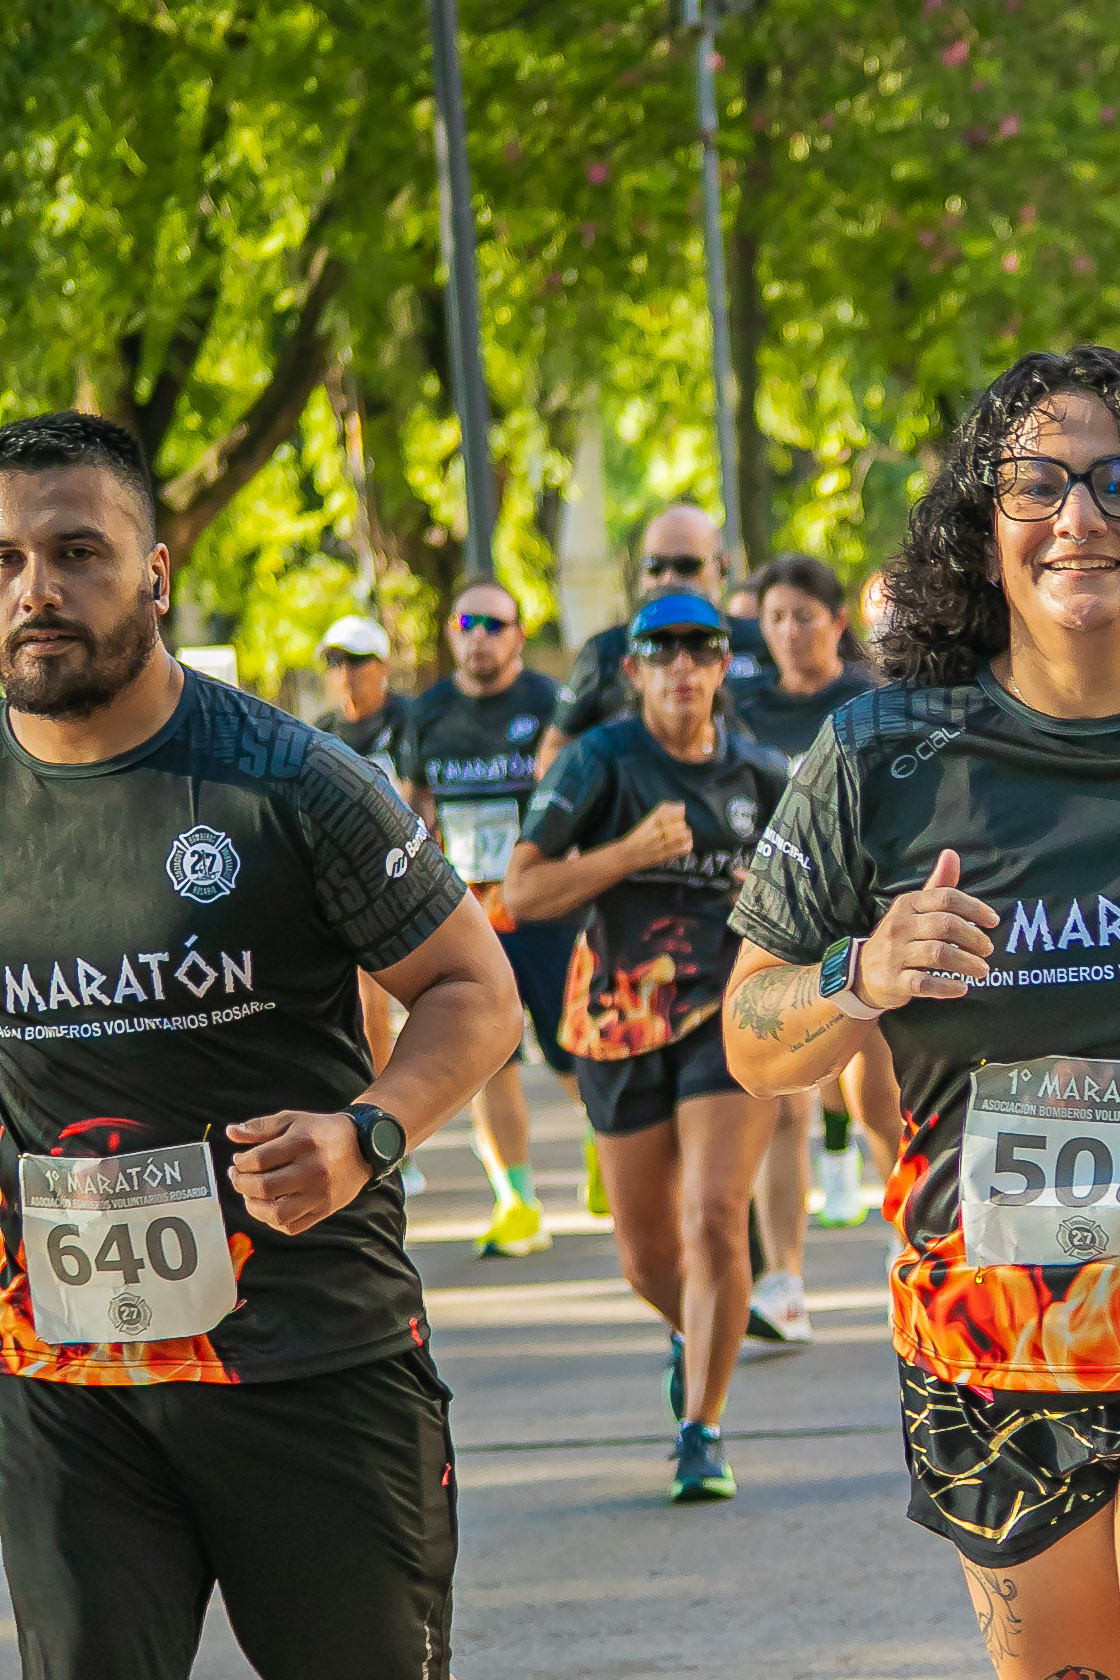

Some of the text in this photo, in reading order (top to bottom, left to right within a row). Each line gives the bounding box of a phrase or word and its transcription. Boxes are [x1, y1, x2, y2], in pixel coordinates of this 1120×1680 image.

[4, 934, 254, 1015] MARATÓN
[1018, 965, 1115, 986] BOMBEROS
[103, 1013, 208, 1035] VOLUNTARIOS
[212, 1002, 276, 1025] ROSARIO
[981, 1099, 1037, 1115] ASOCIACIÓN
[1039, 1106, 1093, 1120] BOMBEROS
[67, 1156, 183, 1195] MARATÓN
[1071, 1229, 1093, 1246] 27
[47, 1216, 199, 1287] 640
[119, 1306, 138, 1321] 27
